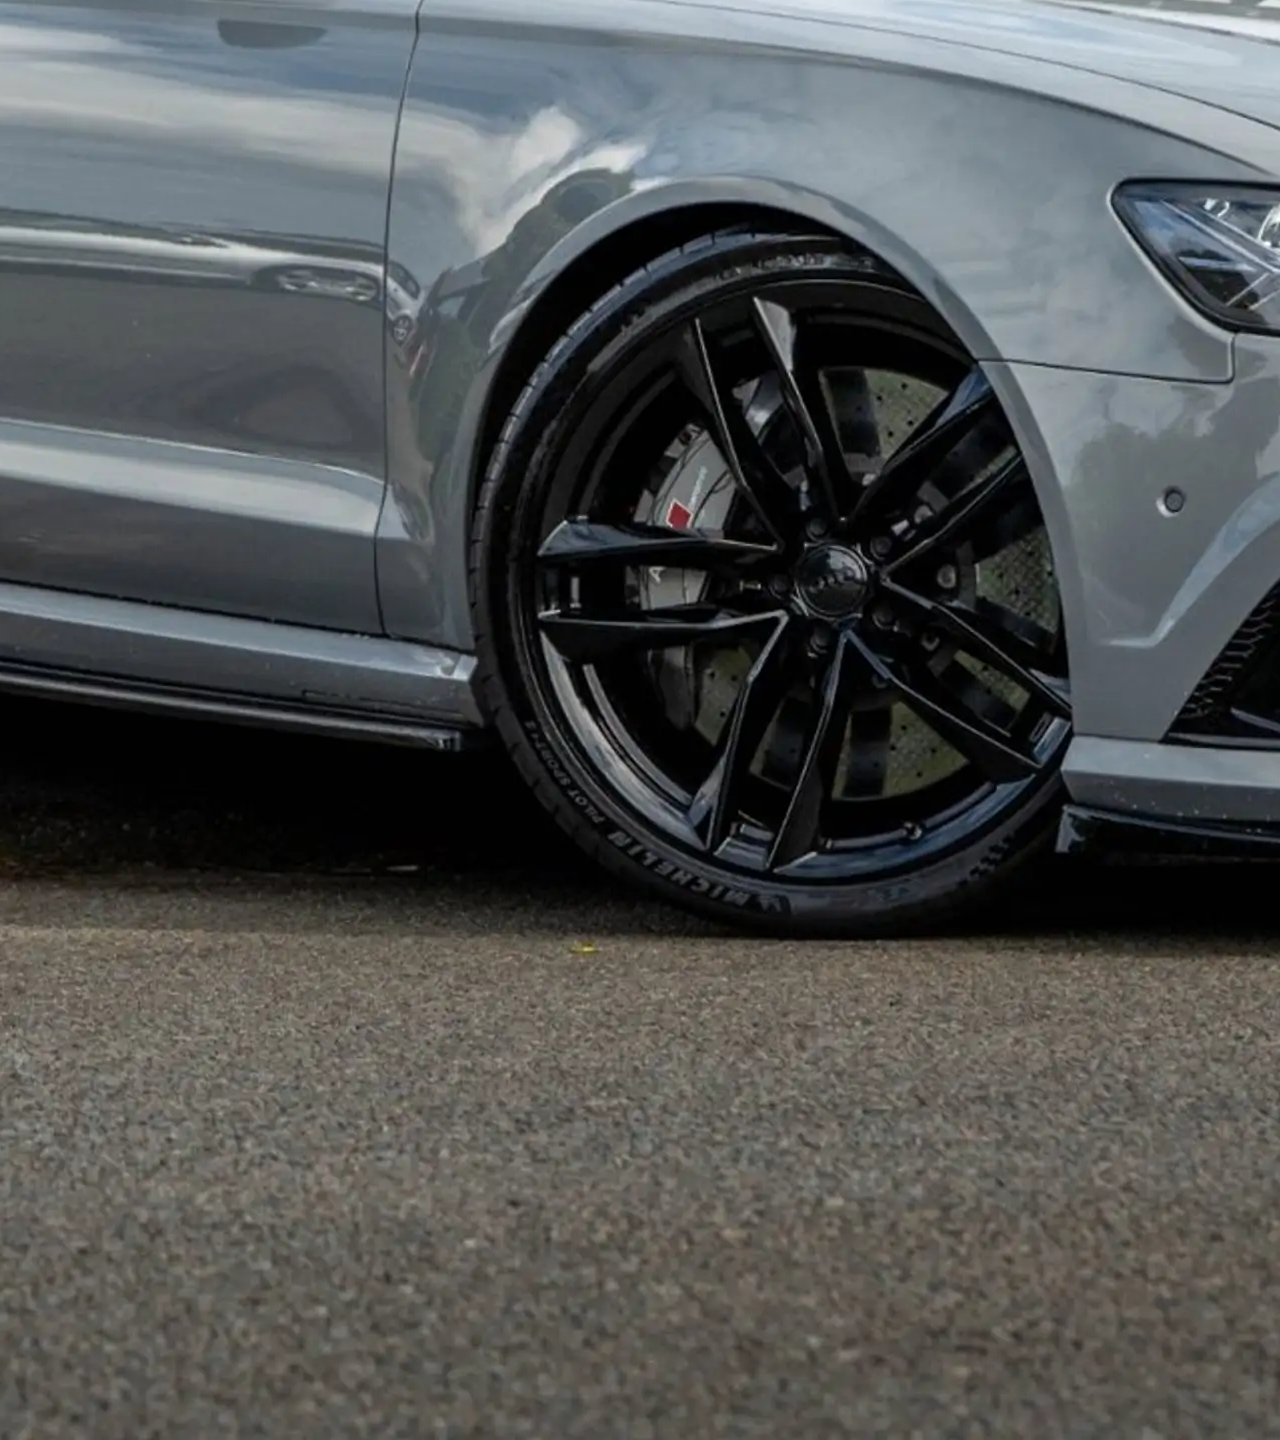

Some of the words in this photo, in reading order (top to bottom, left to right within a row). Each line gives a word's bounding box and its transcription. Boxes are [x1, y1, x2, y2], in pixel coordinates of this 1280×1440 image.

[534, 738, 572, 787] SPORT
[566, 789, 607, 824] PILOT
[607, 830, 752, 907] MICHELIN
